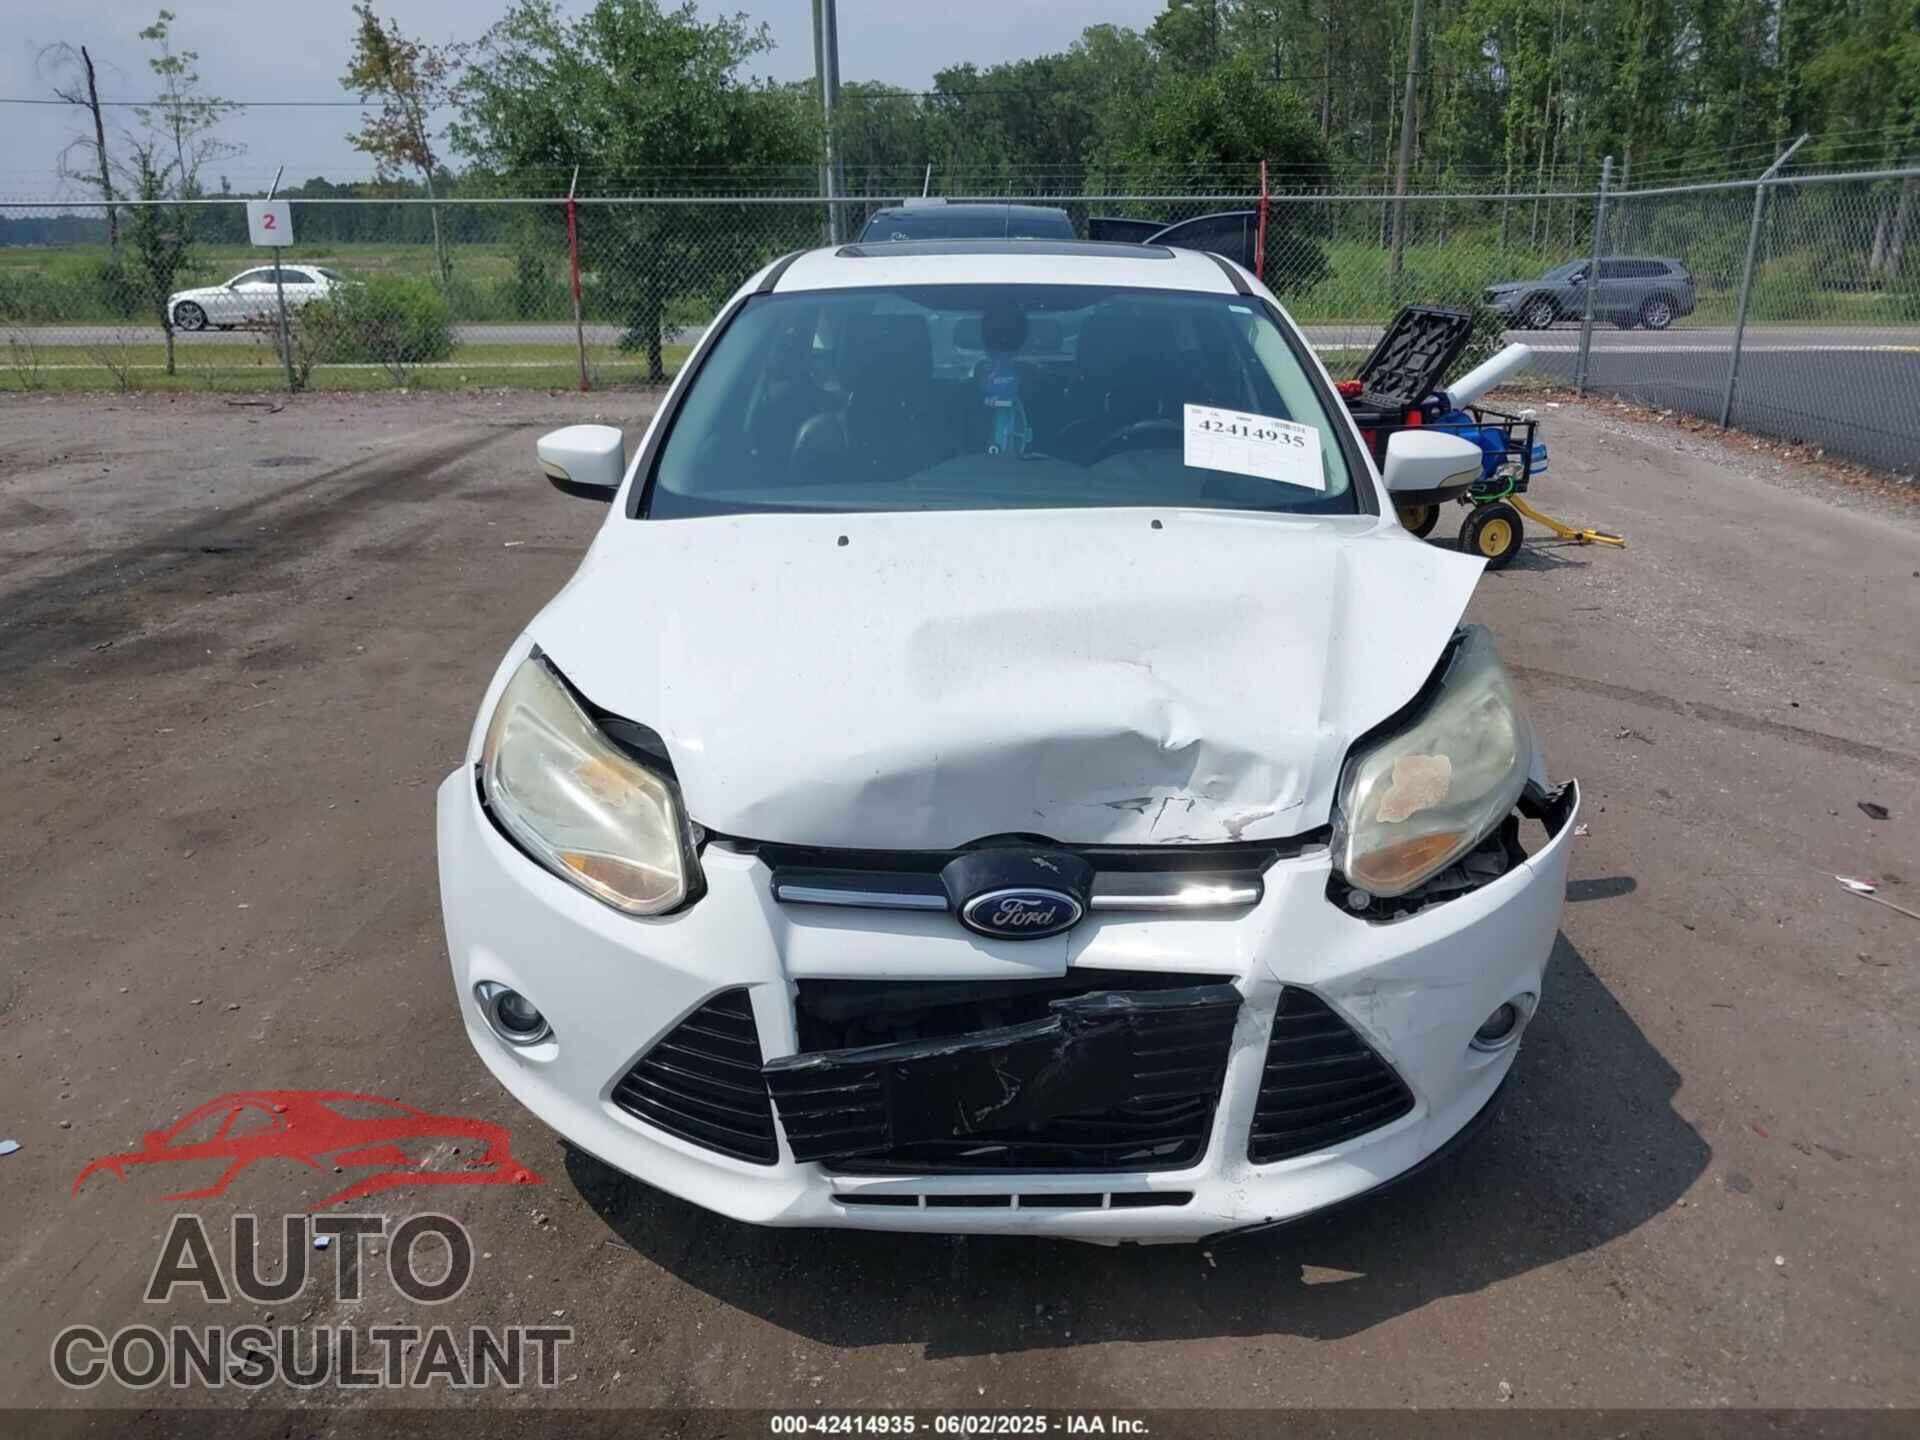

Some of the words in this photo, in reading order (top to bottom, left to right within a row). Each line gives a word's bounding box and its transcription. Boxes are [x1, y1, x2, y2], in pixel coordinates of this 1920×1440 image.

[263, 213, 277, 230] 2
[1199, 420, 1305, 448] 42414935
[993, 898, 1056, 926] Ford
